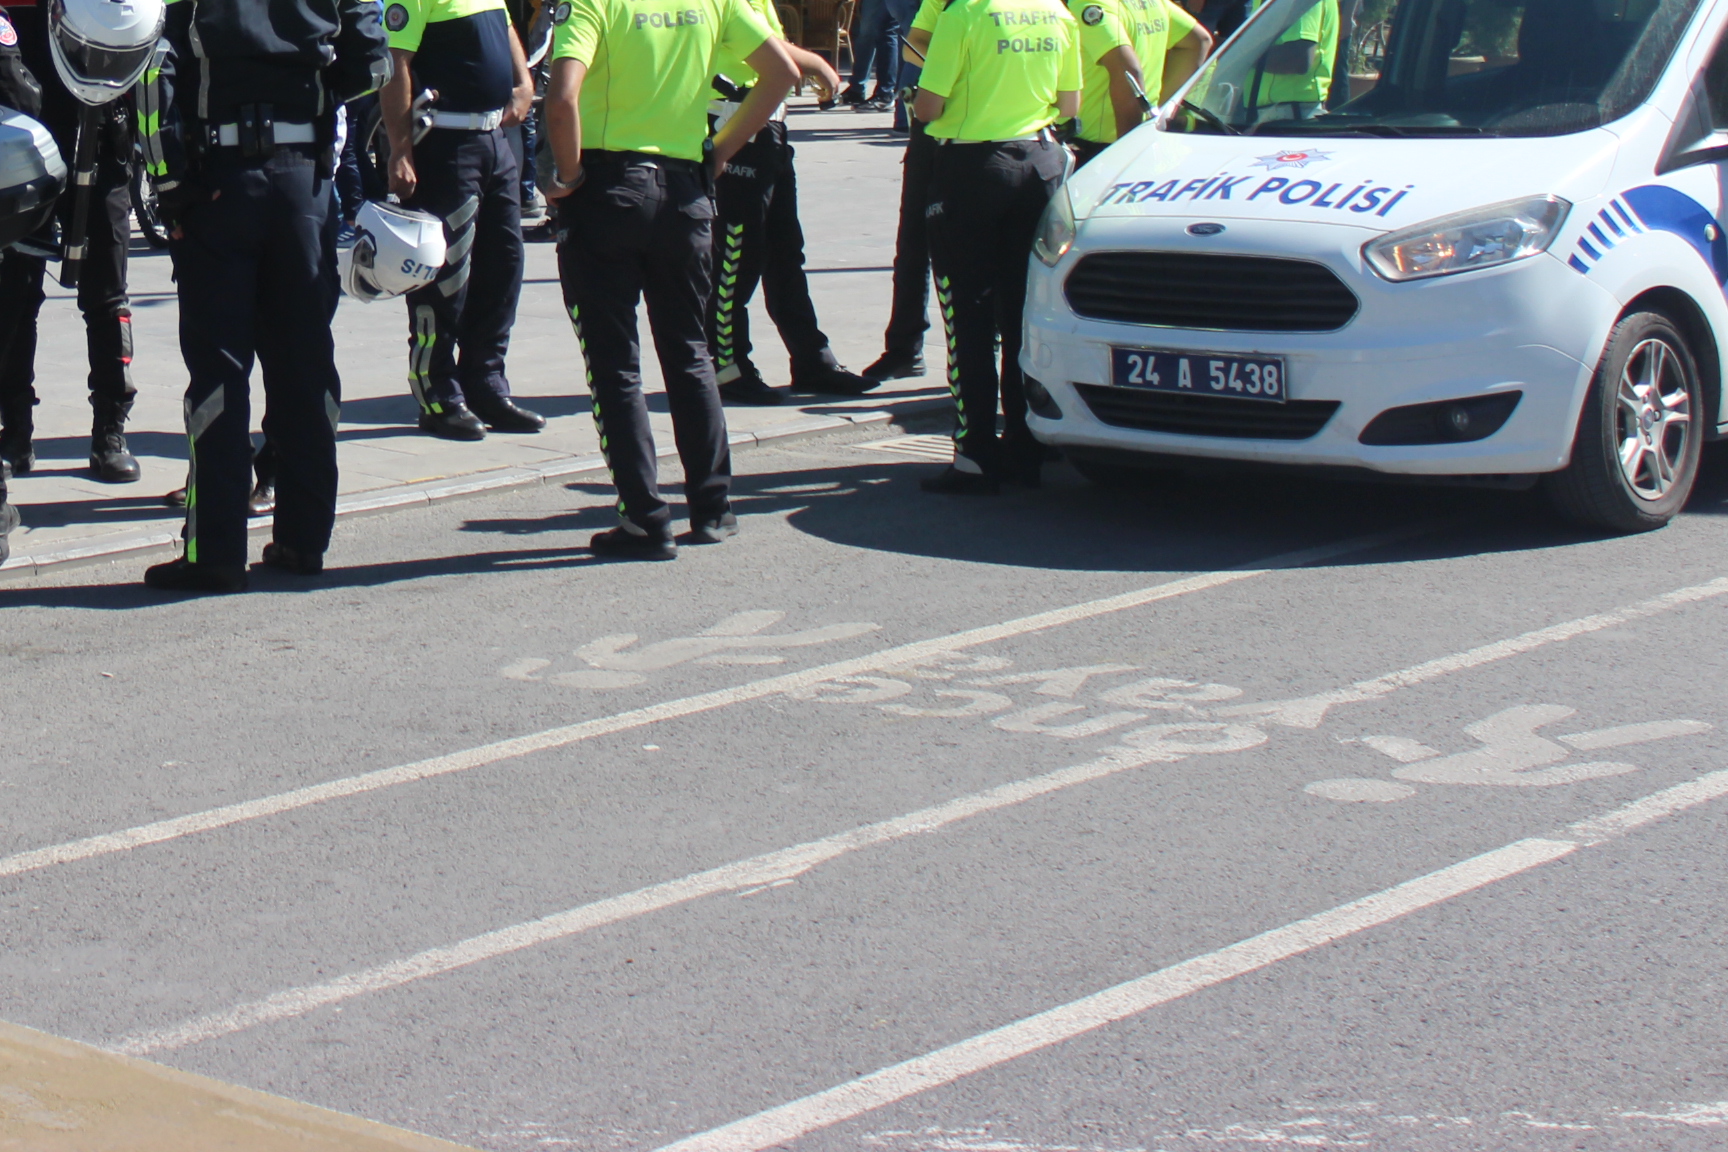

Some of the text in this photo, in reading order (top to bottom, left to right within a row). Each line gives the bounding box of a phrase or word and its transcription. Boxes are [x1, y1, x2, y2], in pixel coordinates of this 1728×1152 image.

[635, 9, 705, 29] POLİSİ
[989, 10, 1060, 28] TRAFİK
[997, 37, 1060, 54] POLİSİ
[1098, 171, 1416, 217] TRAFİK POLİSİ
[1127, 354, 1279, 395] 24 A 5438
